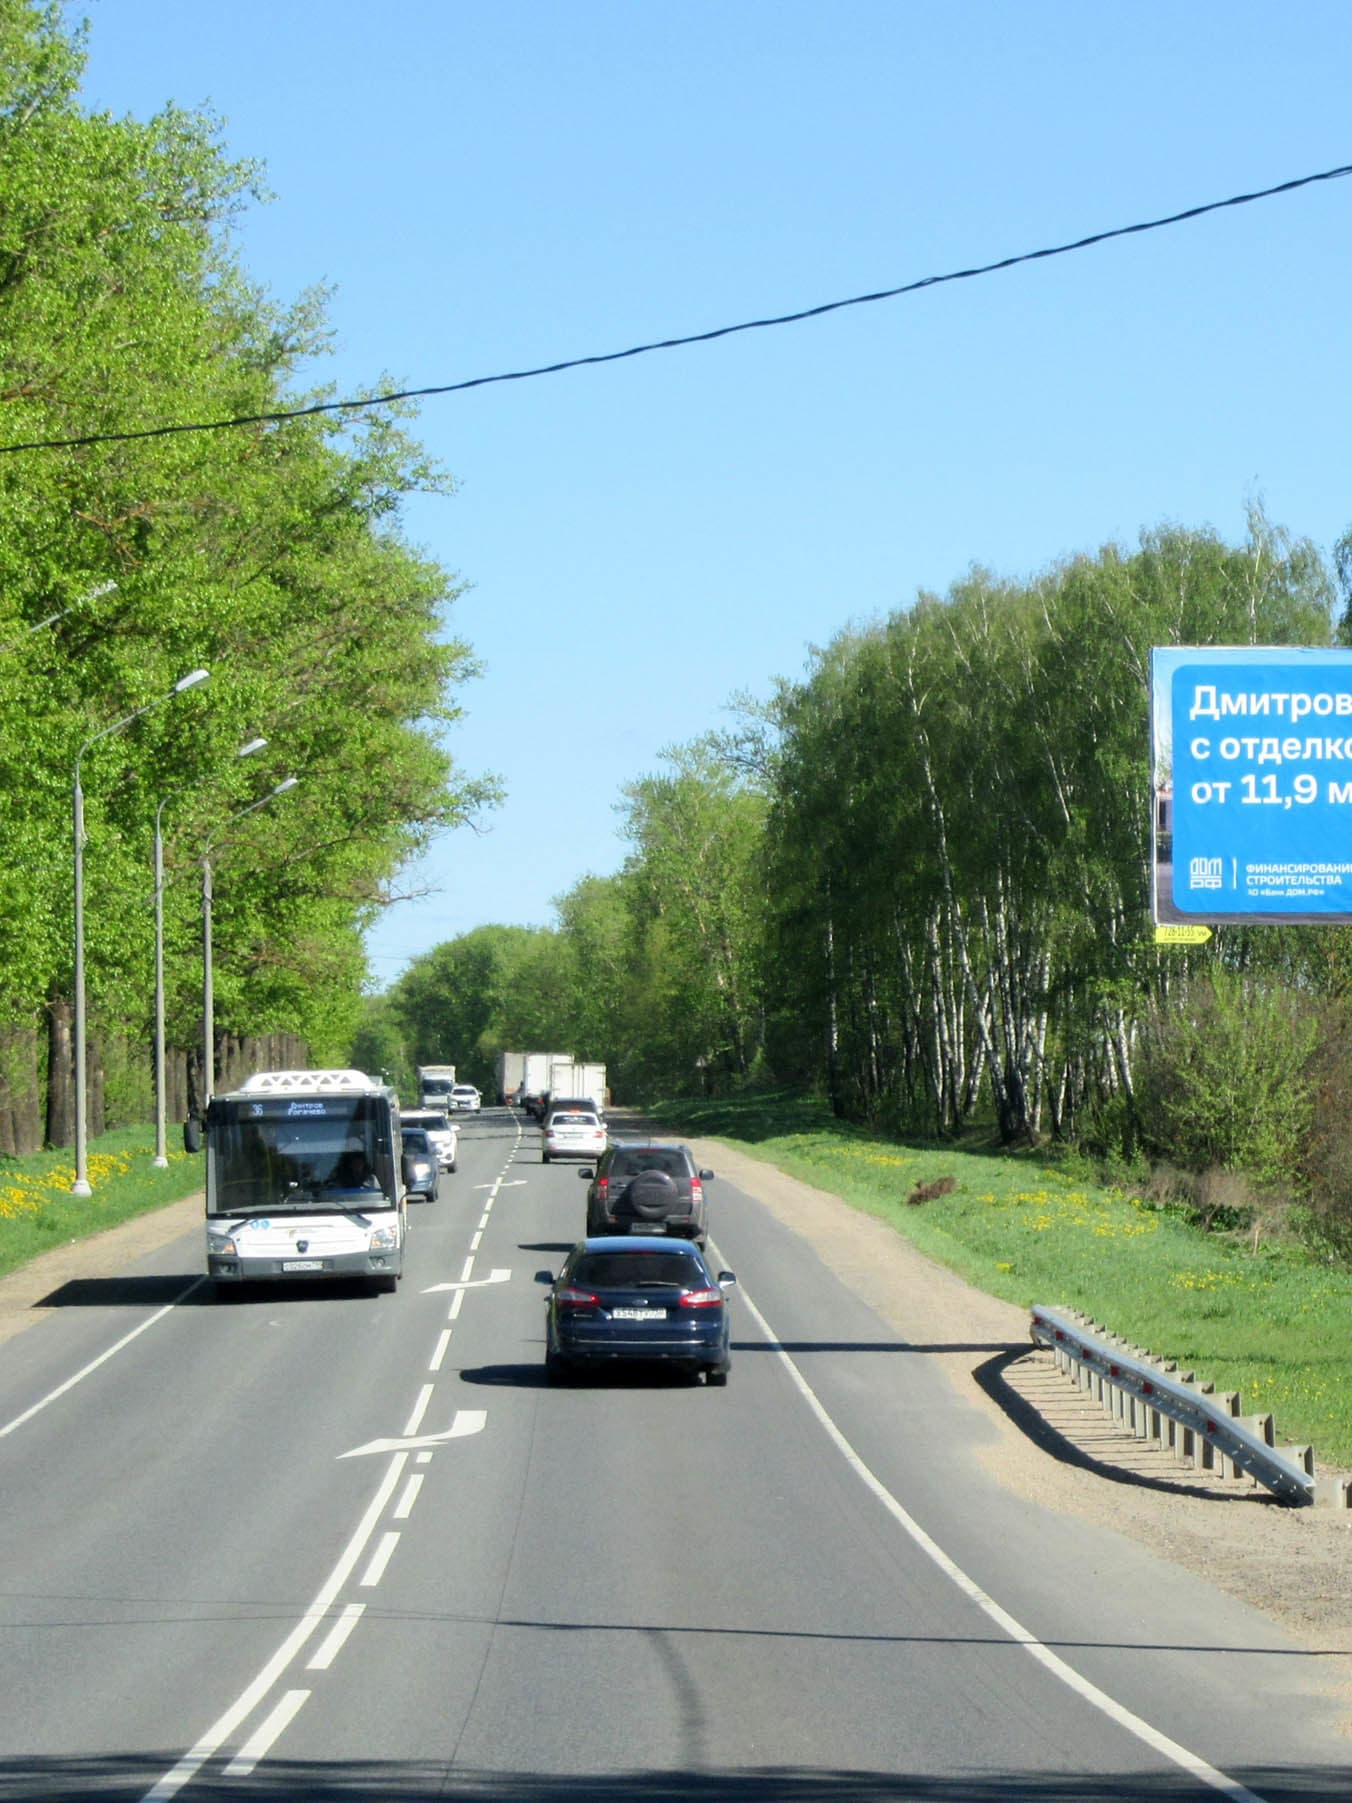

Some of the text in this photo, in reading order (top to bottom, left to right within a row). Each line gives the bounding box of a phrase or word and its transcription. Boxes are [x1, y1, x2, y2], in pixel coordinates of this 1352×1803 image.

[1190, 685, 1352, 722] Дмитров
[1190, 737, 1210, 760] с
[1191, 780, 1231, 804] от
[1240, 774, 1318, 810] 11,9
[1246, 875, 1342, 886] СТРОИТЕЛЬСТВА
